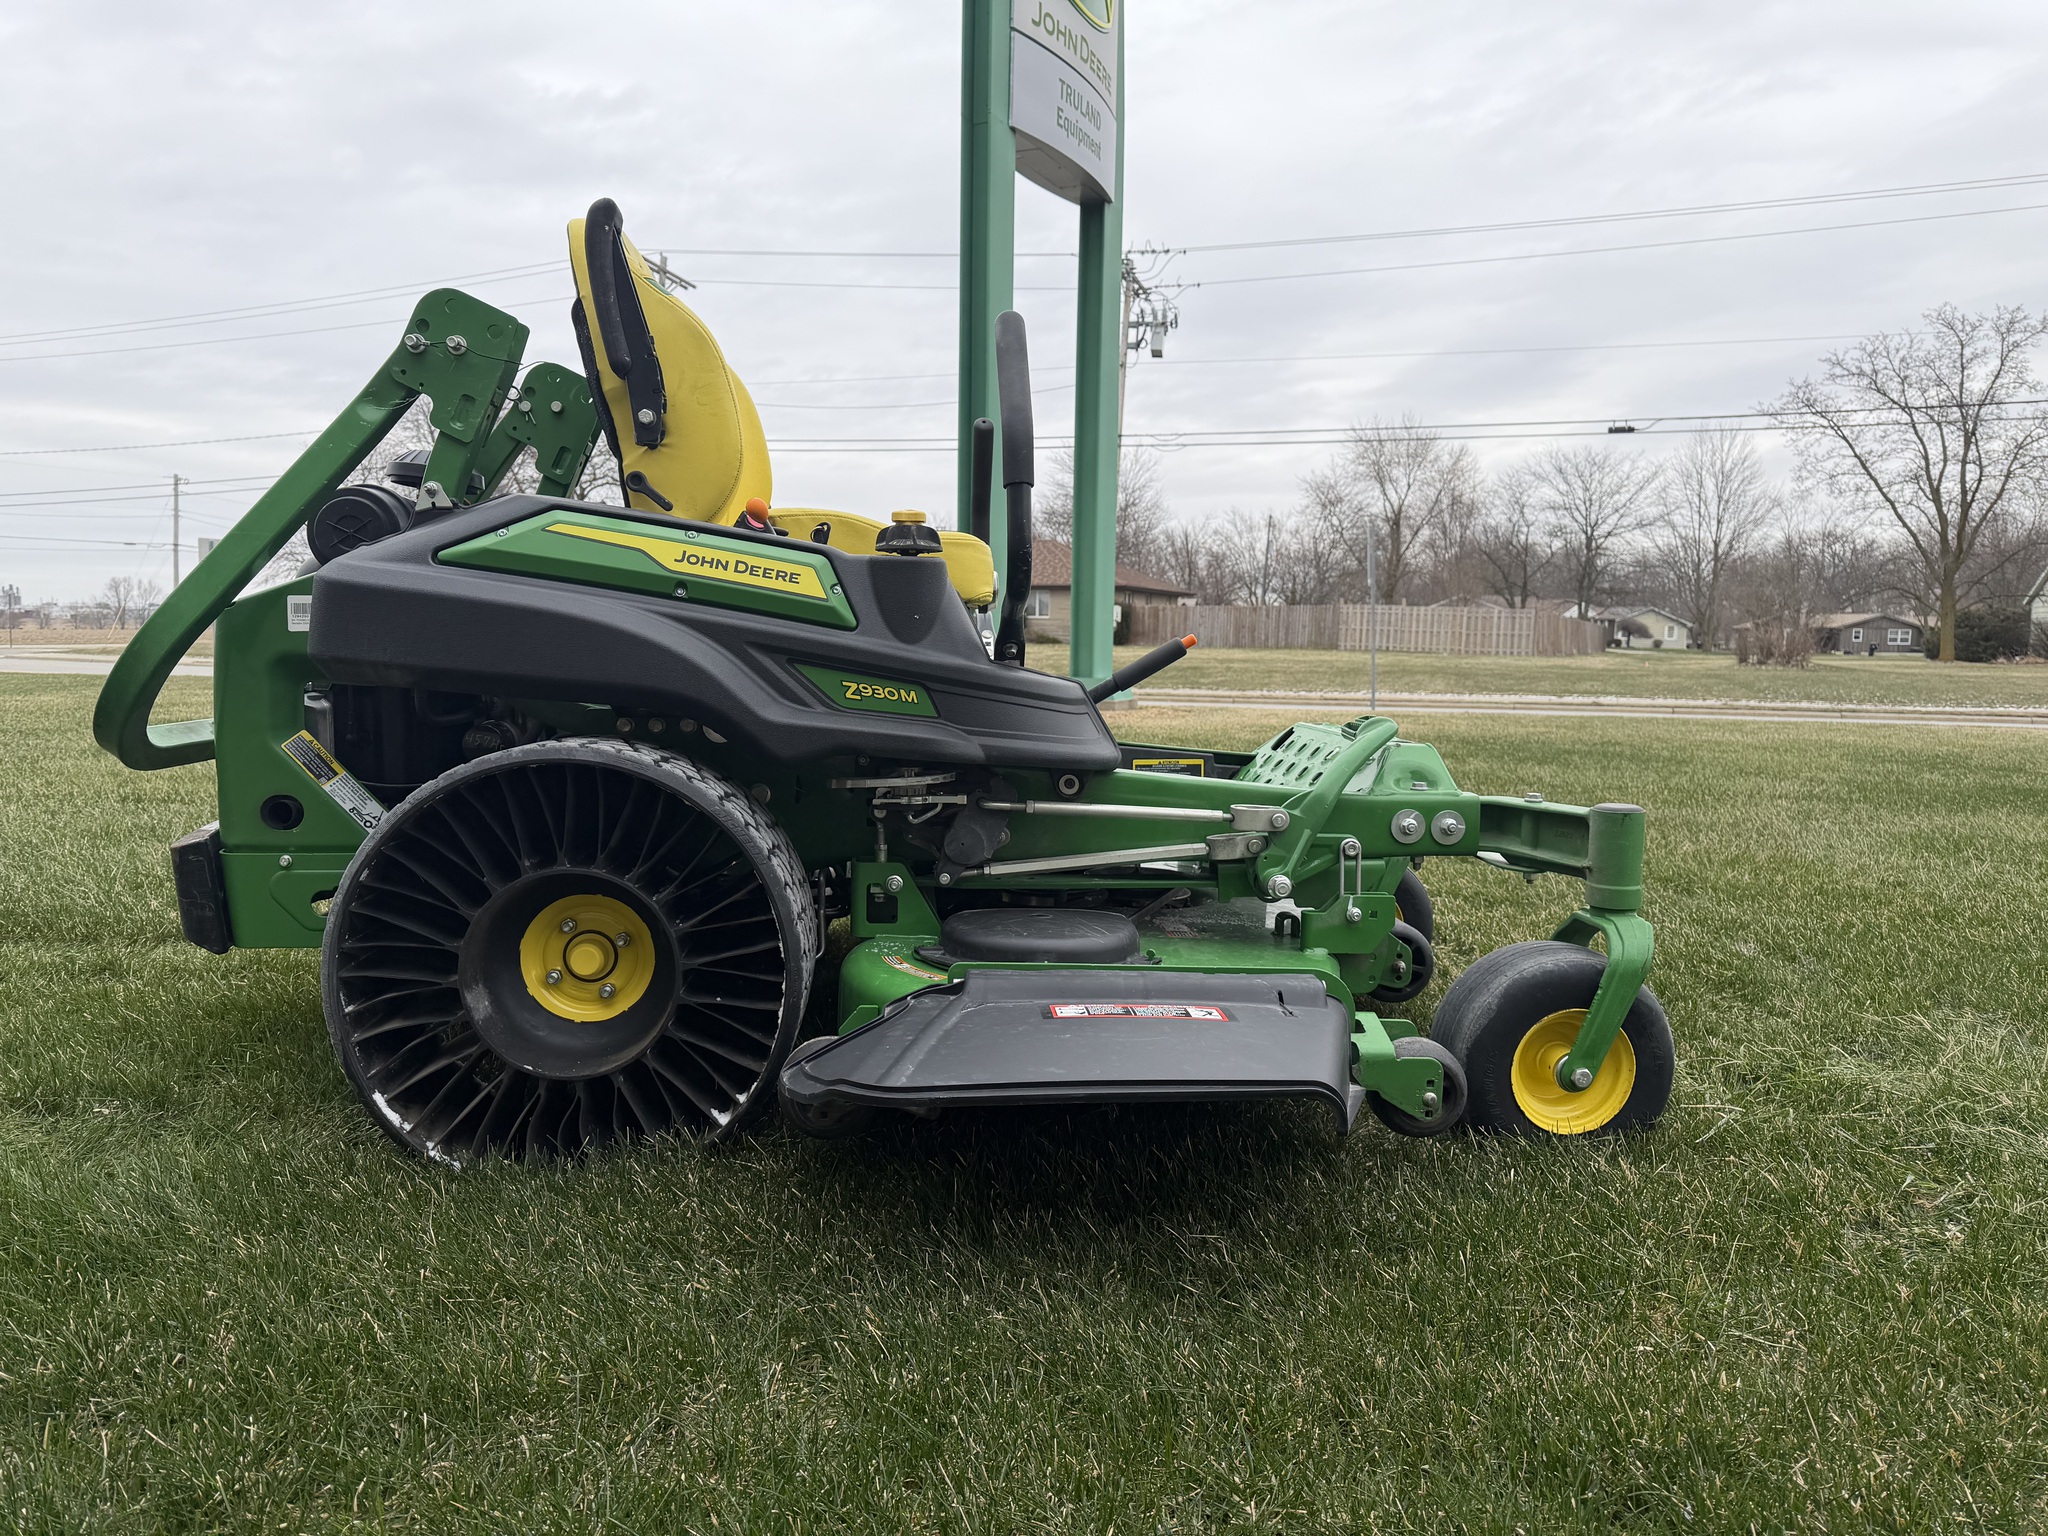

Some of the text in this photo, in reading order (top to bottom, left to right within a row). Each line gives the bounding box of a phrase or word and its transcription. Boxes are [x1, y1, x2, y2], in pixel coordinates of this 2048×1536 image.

[1031, 1, 1112, 97] JOHN DEERE
[1058, 77, 1102, 132] TRULAND
[1056, 105, 1102, 161] Equipment
[674, 550, 801, 584] JOHN DEERE
[841, 680, 919, 704] Z930M
[312, 742, 335, 765] CAUTION
[710, 805, 768, 866] MICHELIN
